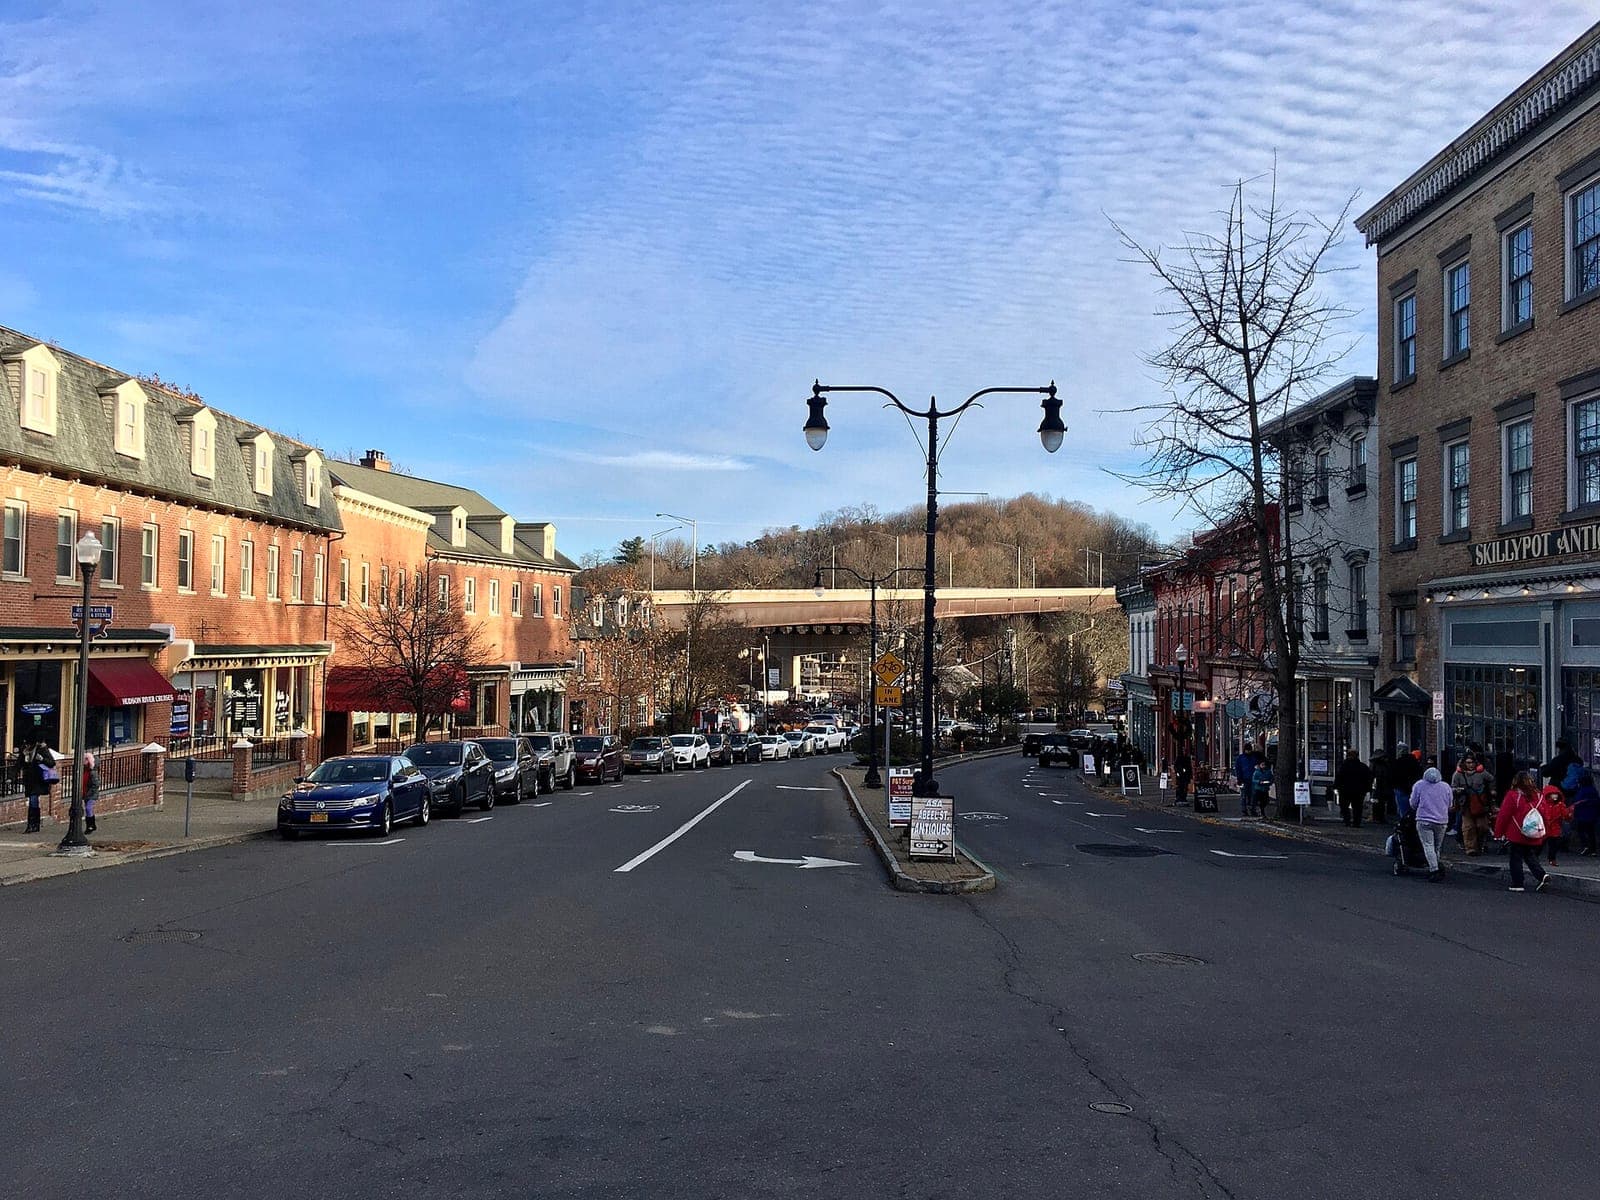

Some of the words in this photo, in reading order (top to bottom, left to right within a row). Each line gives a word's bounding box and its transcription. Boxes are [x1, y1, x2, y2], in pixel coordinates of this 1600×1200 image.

[1476, 533, 1551, 566] SKILLYPOT
[1557, 525, 1600, 554] ANTI
[122, 697, 141, 705] HUDSON
[156, 694, 173, 702] CRUISES
[913, 822, 951, 836] ANTIQUES
